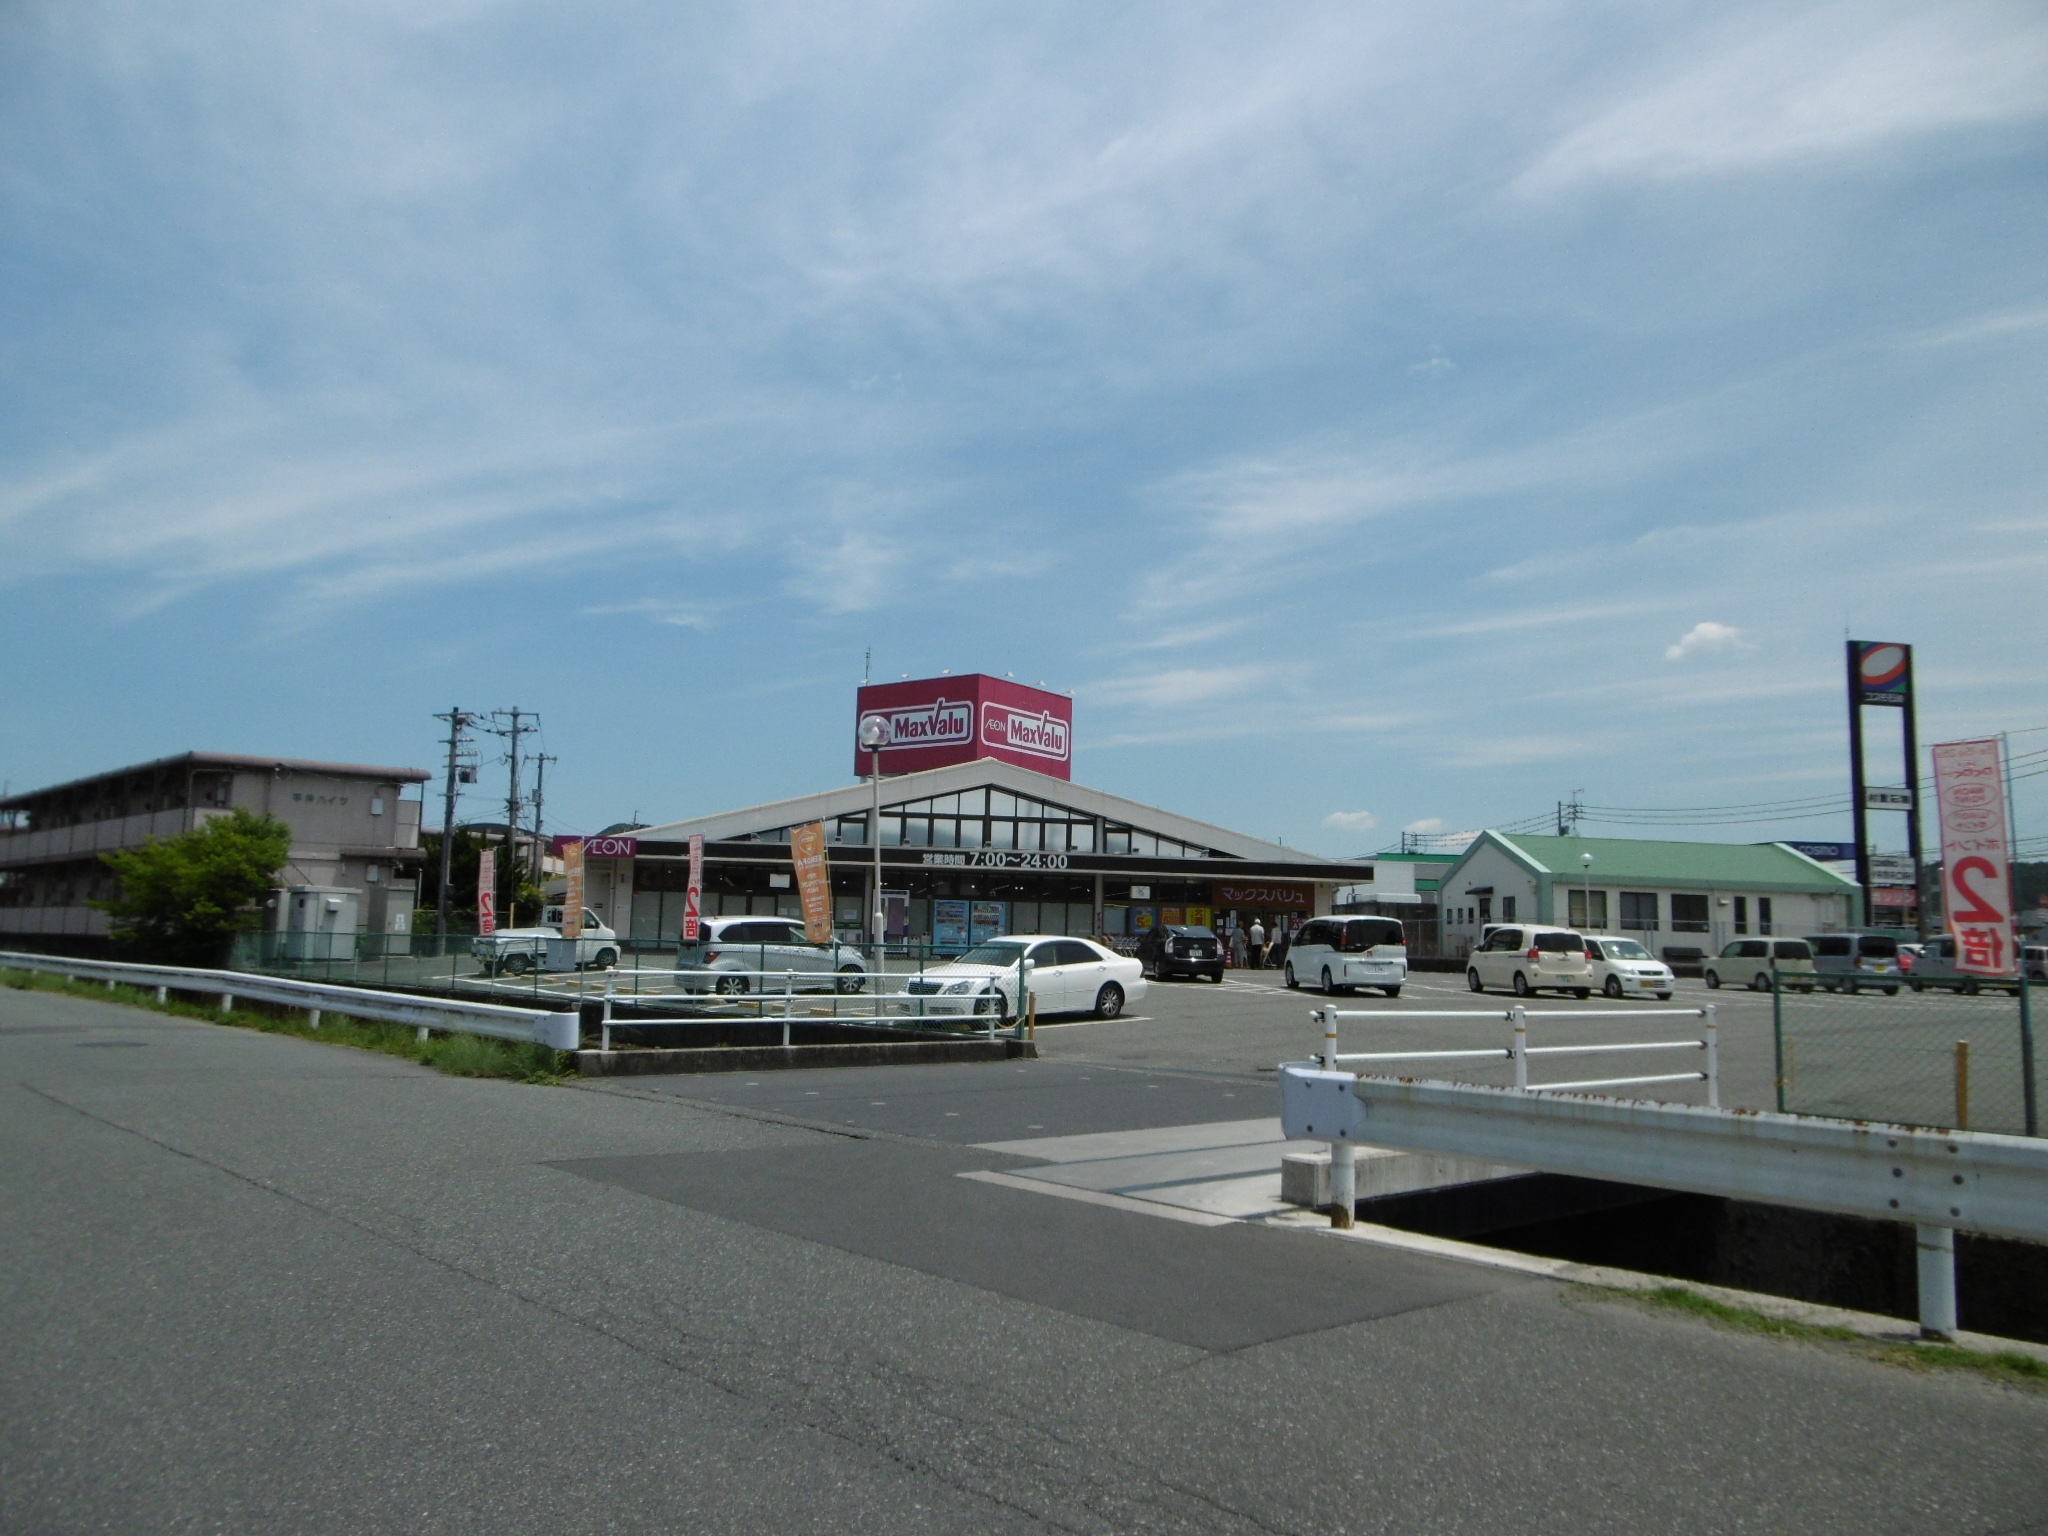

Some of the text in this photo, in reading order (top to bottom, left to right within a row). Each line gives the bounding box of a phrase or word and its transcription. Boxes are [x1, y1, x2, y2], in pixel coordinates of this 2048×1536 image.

[894, 700, 965, 739] MaxValu
[1010, 713, 1063, 749] MaxValu
[922, 853, 966, 866] 営業時間
[1221, 886, 1305, 903] マックスバリュ
